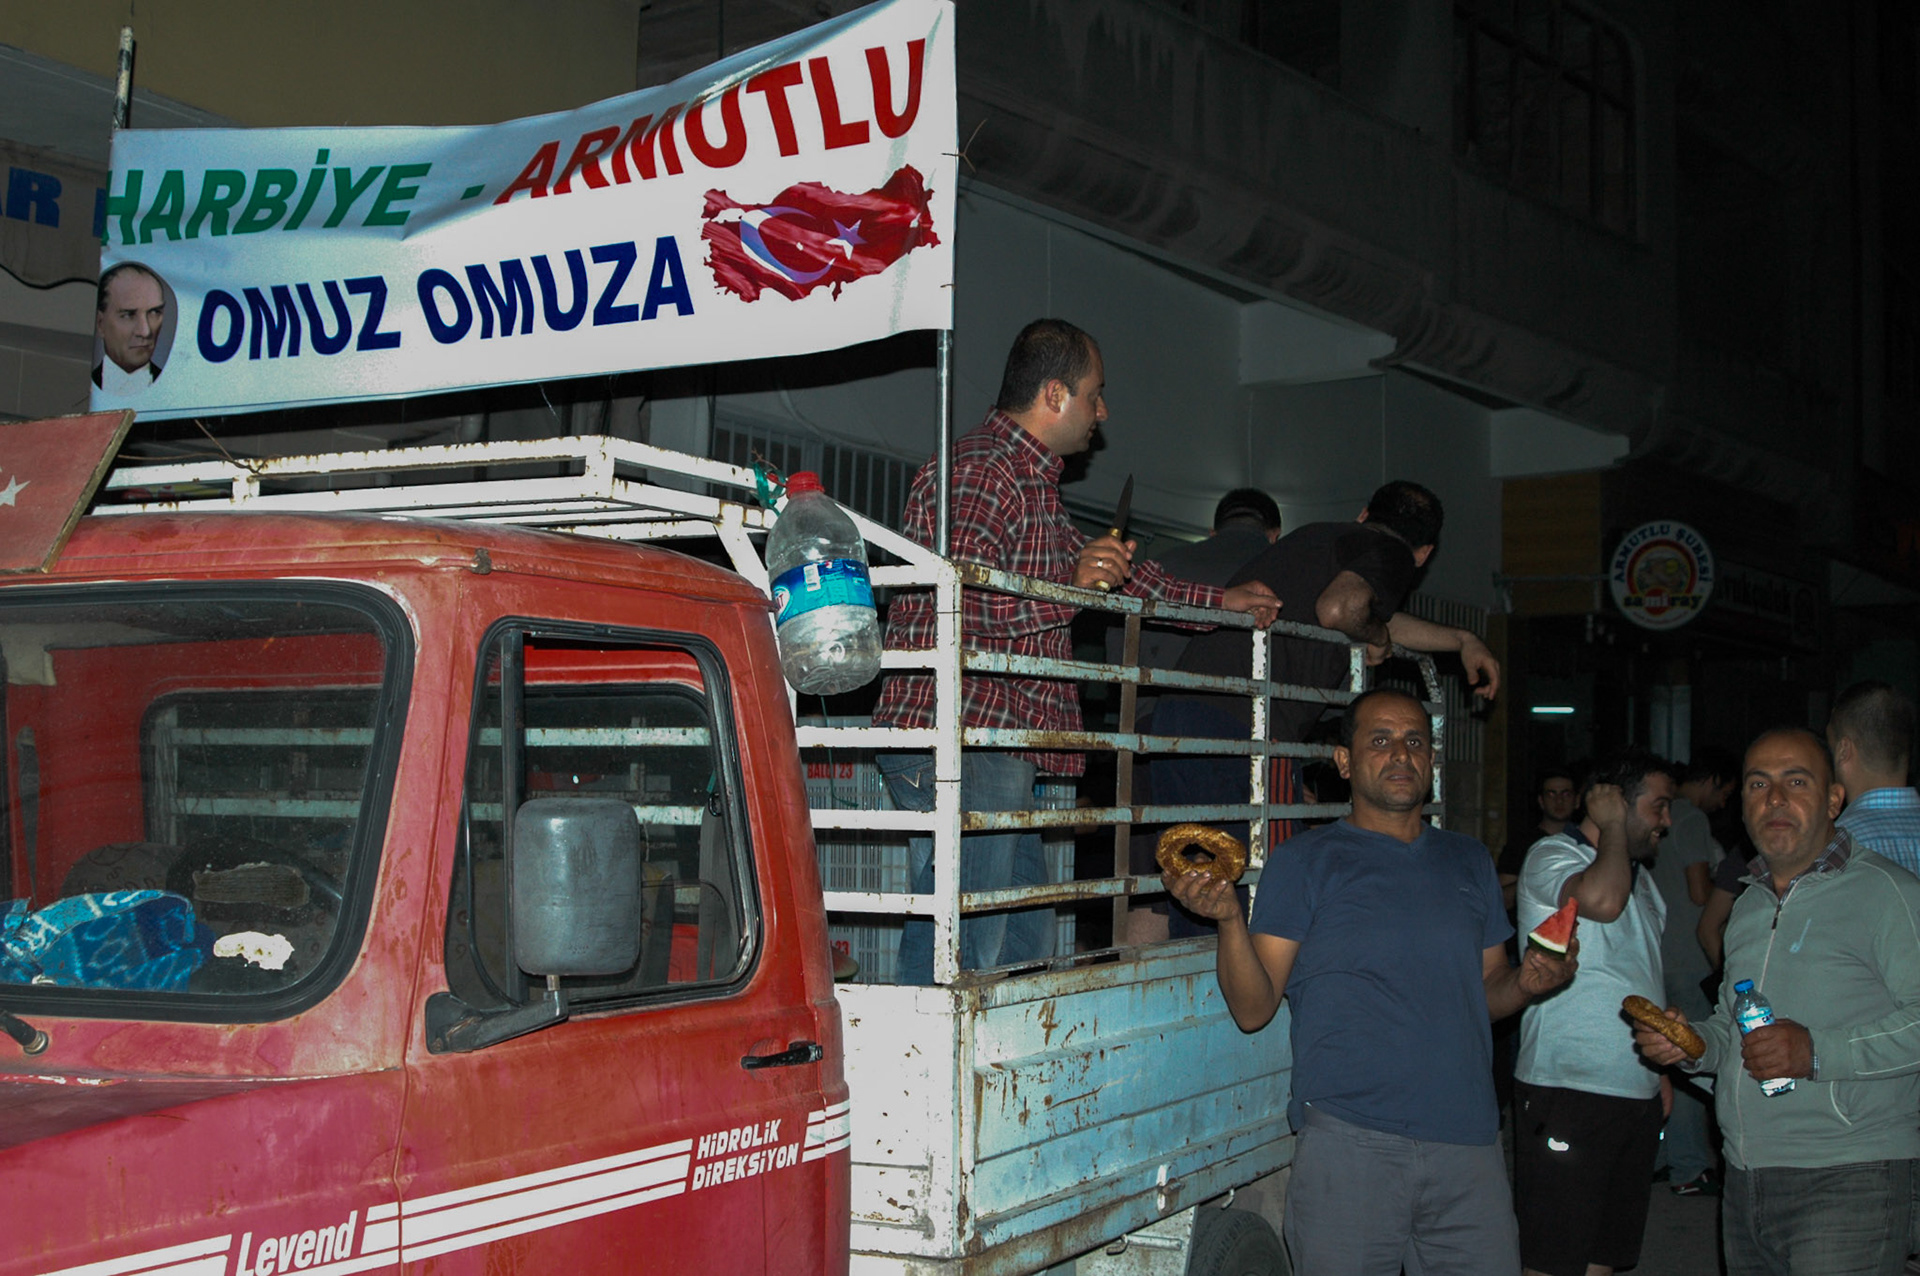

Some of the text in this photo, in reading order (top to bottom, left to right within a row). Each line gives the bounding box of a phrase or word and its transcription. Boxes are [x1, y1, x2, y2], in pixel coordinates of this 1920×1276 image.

[102, 149, 430, 246] HARBİYE
[494, 38, 926, 205] ARMUTLU
[0, 166, 62, 229] R
[196, 235, 695, 364] OMUZ OMUZA
[1614, 524, 1671, 583] ARMUTLU
[235, 1209, 358, 1276] Levend
